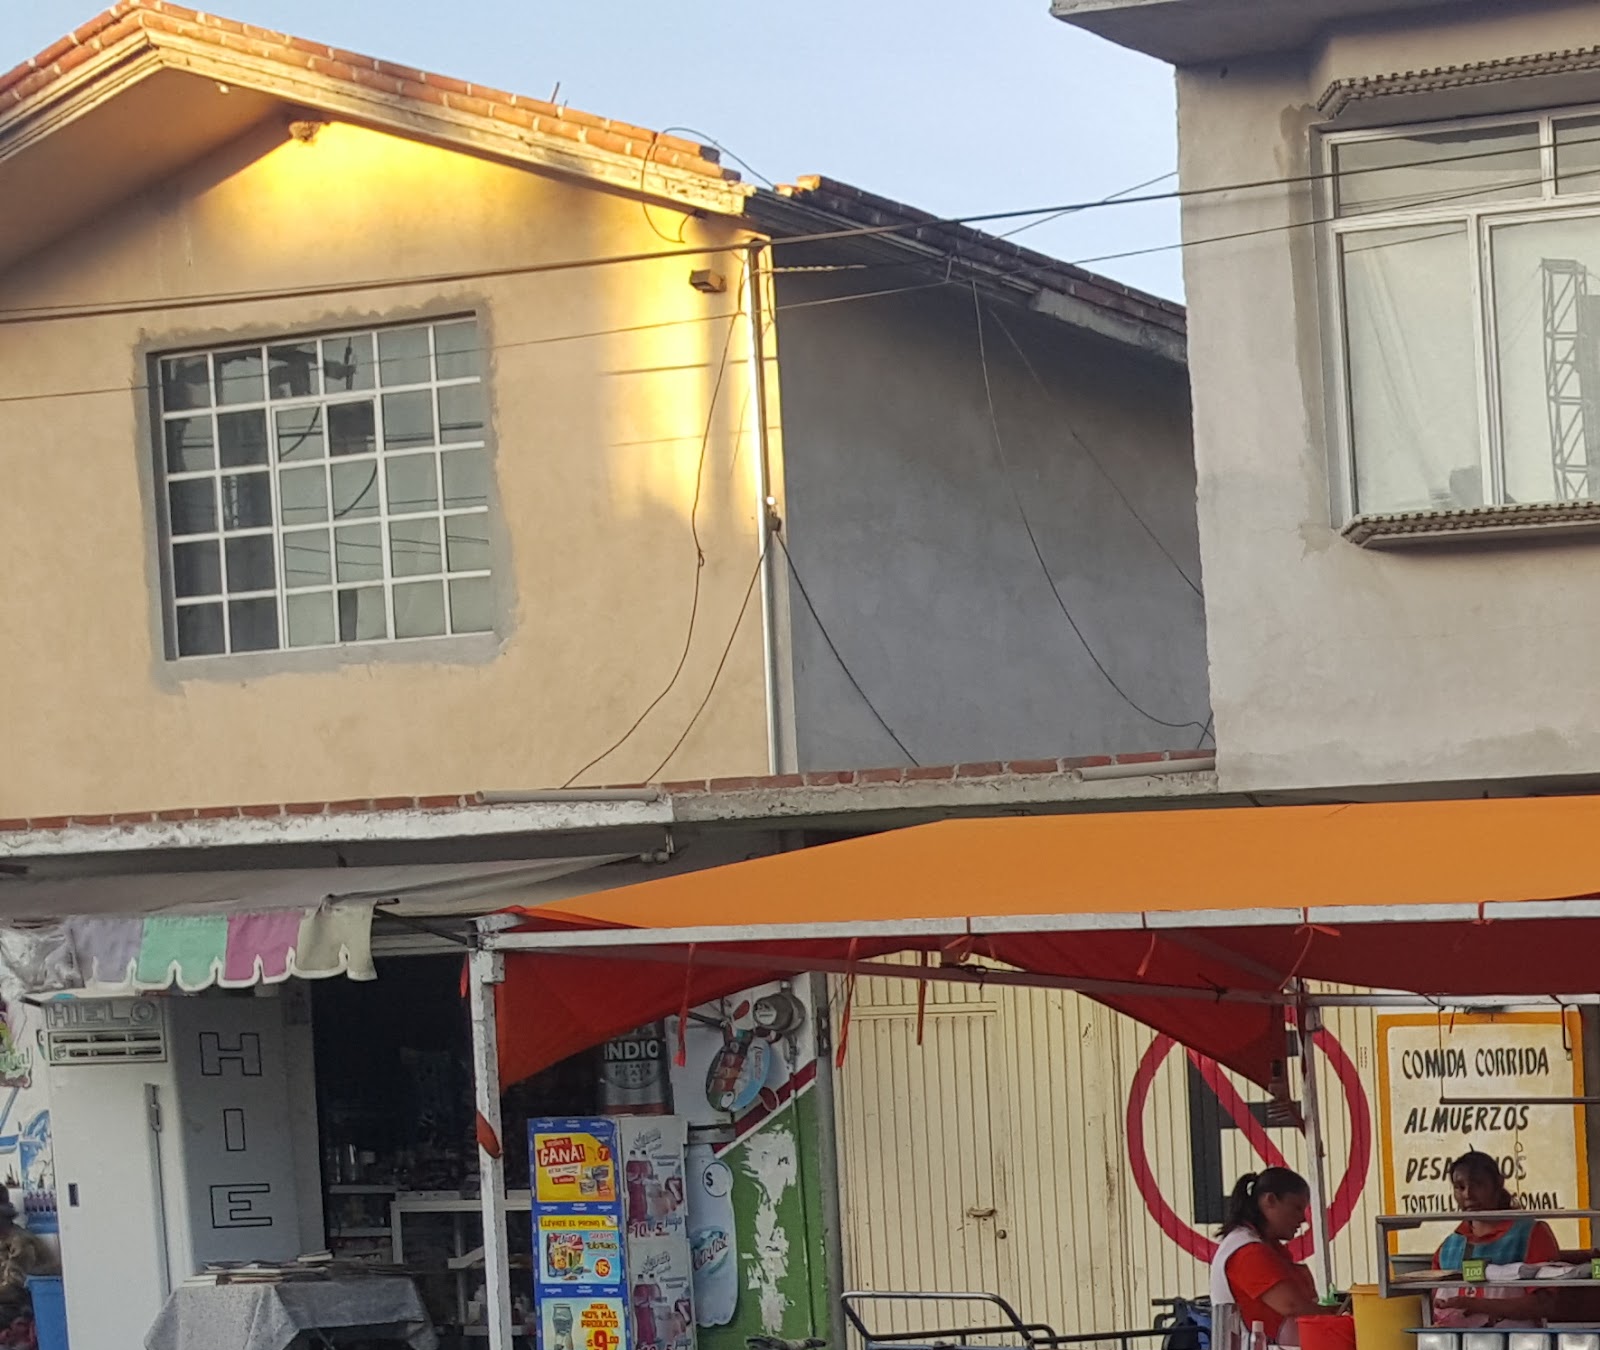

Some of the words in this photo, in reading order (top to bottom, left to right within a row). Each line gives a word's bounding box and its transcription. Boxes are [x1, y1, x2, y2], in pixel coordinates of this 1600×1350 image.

[50, 1001, 158, 1027] HIELO
[604, 1040, 659, 1061] INDIO
[1402, 1048, 1468, 1080] COMIDA
[1475, 1047, 1549, 1078] CORRIDA
[199, 1032, 273, 1228] HIE
[1404, 1106, 1530, 1135] ALMUERZOS
[540, 1145, 585, 1166] GANA!
[1405, 1155, 1527, 1184] DESAOS
[1401, 1194, 1462, 1213] TORTILL
[1465, 1267, 1482, 1277] 100
